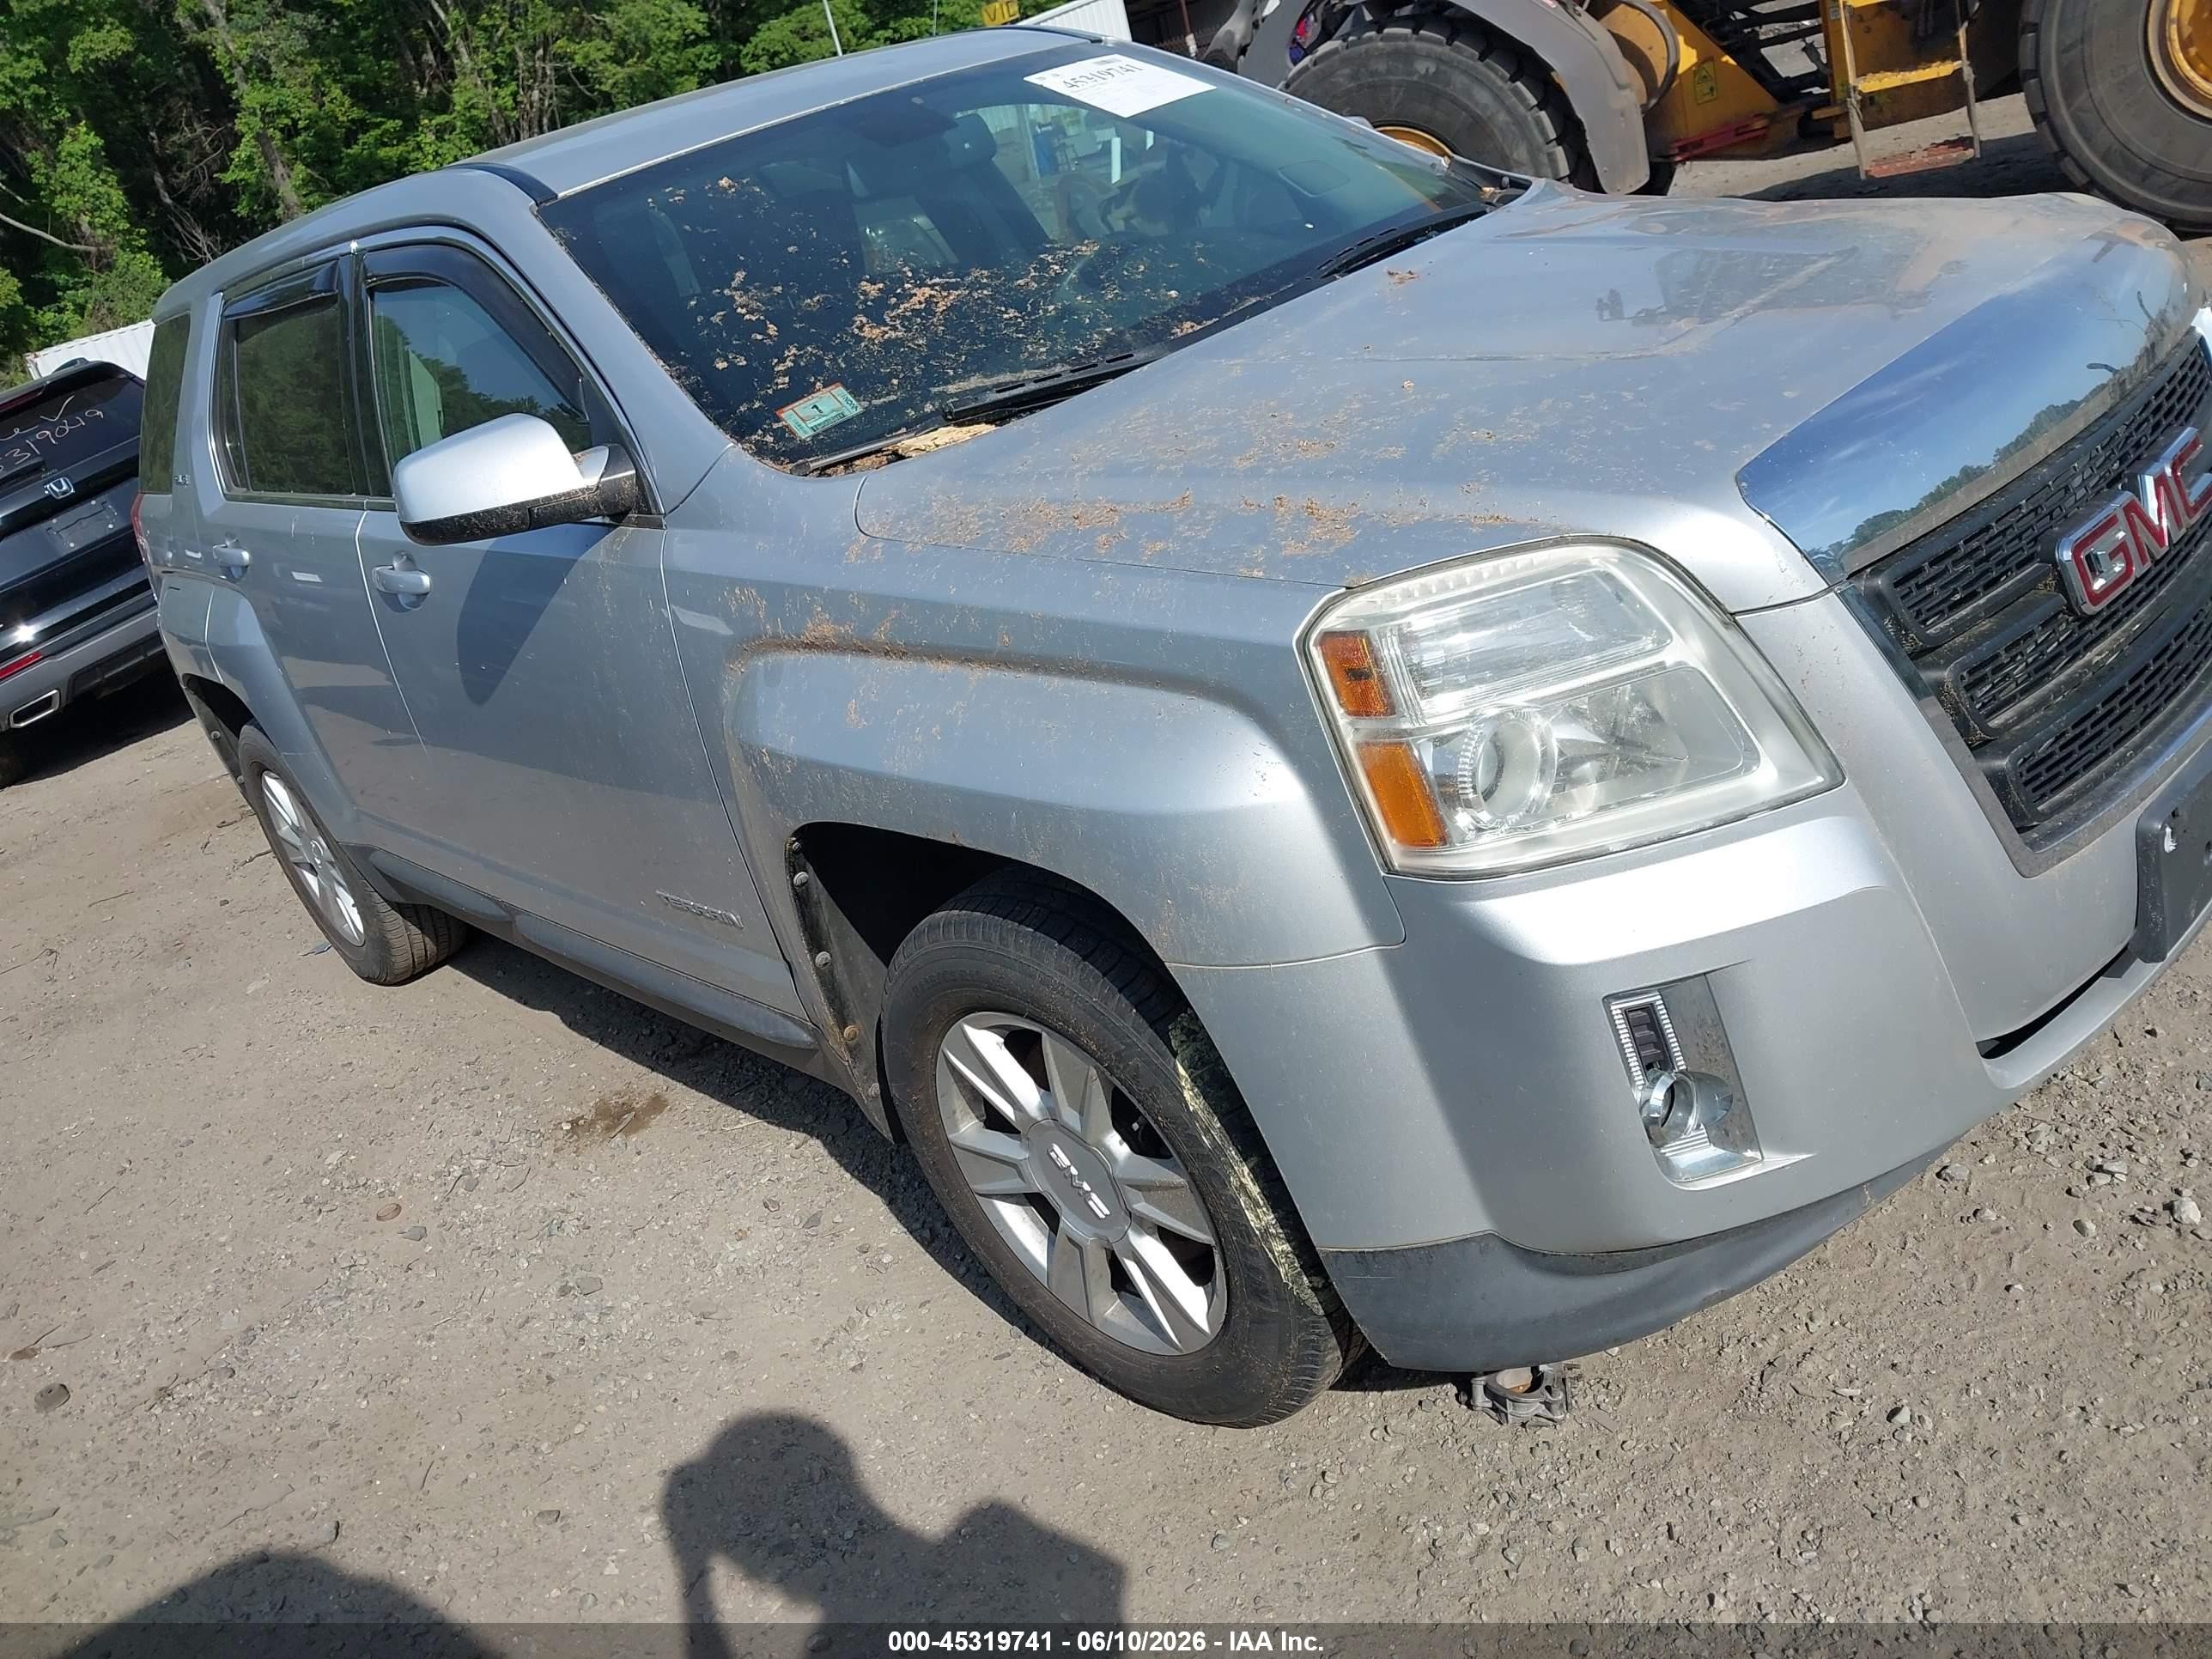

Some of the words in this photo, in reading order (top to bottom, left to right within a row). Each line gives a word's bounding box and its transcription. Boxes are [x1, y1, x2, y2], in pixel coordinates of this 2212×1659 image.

[1062, 64, 1145, 90] 45319741
[811, 404, 823, 414] 1
[2056, 427, 2212, 616] GMC
[1046, 1142, 1111, 1219] GMC
